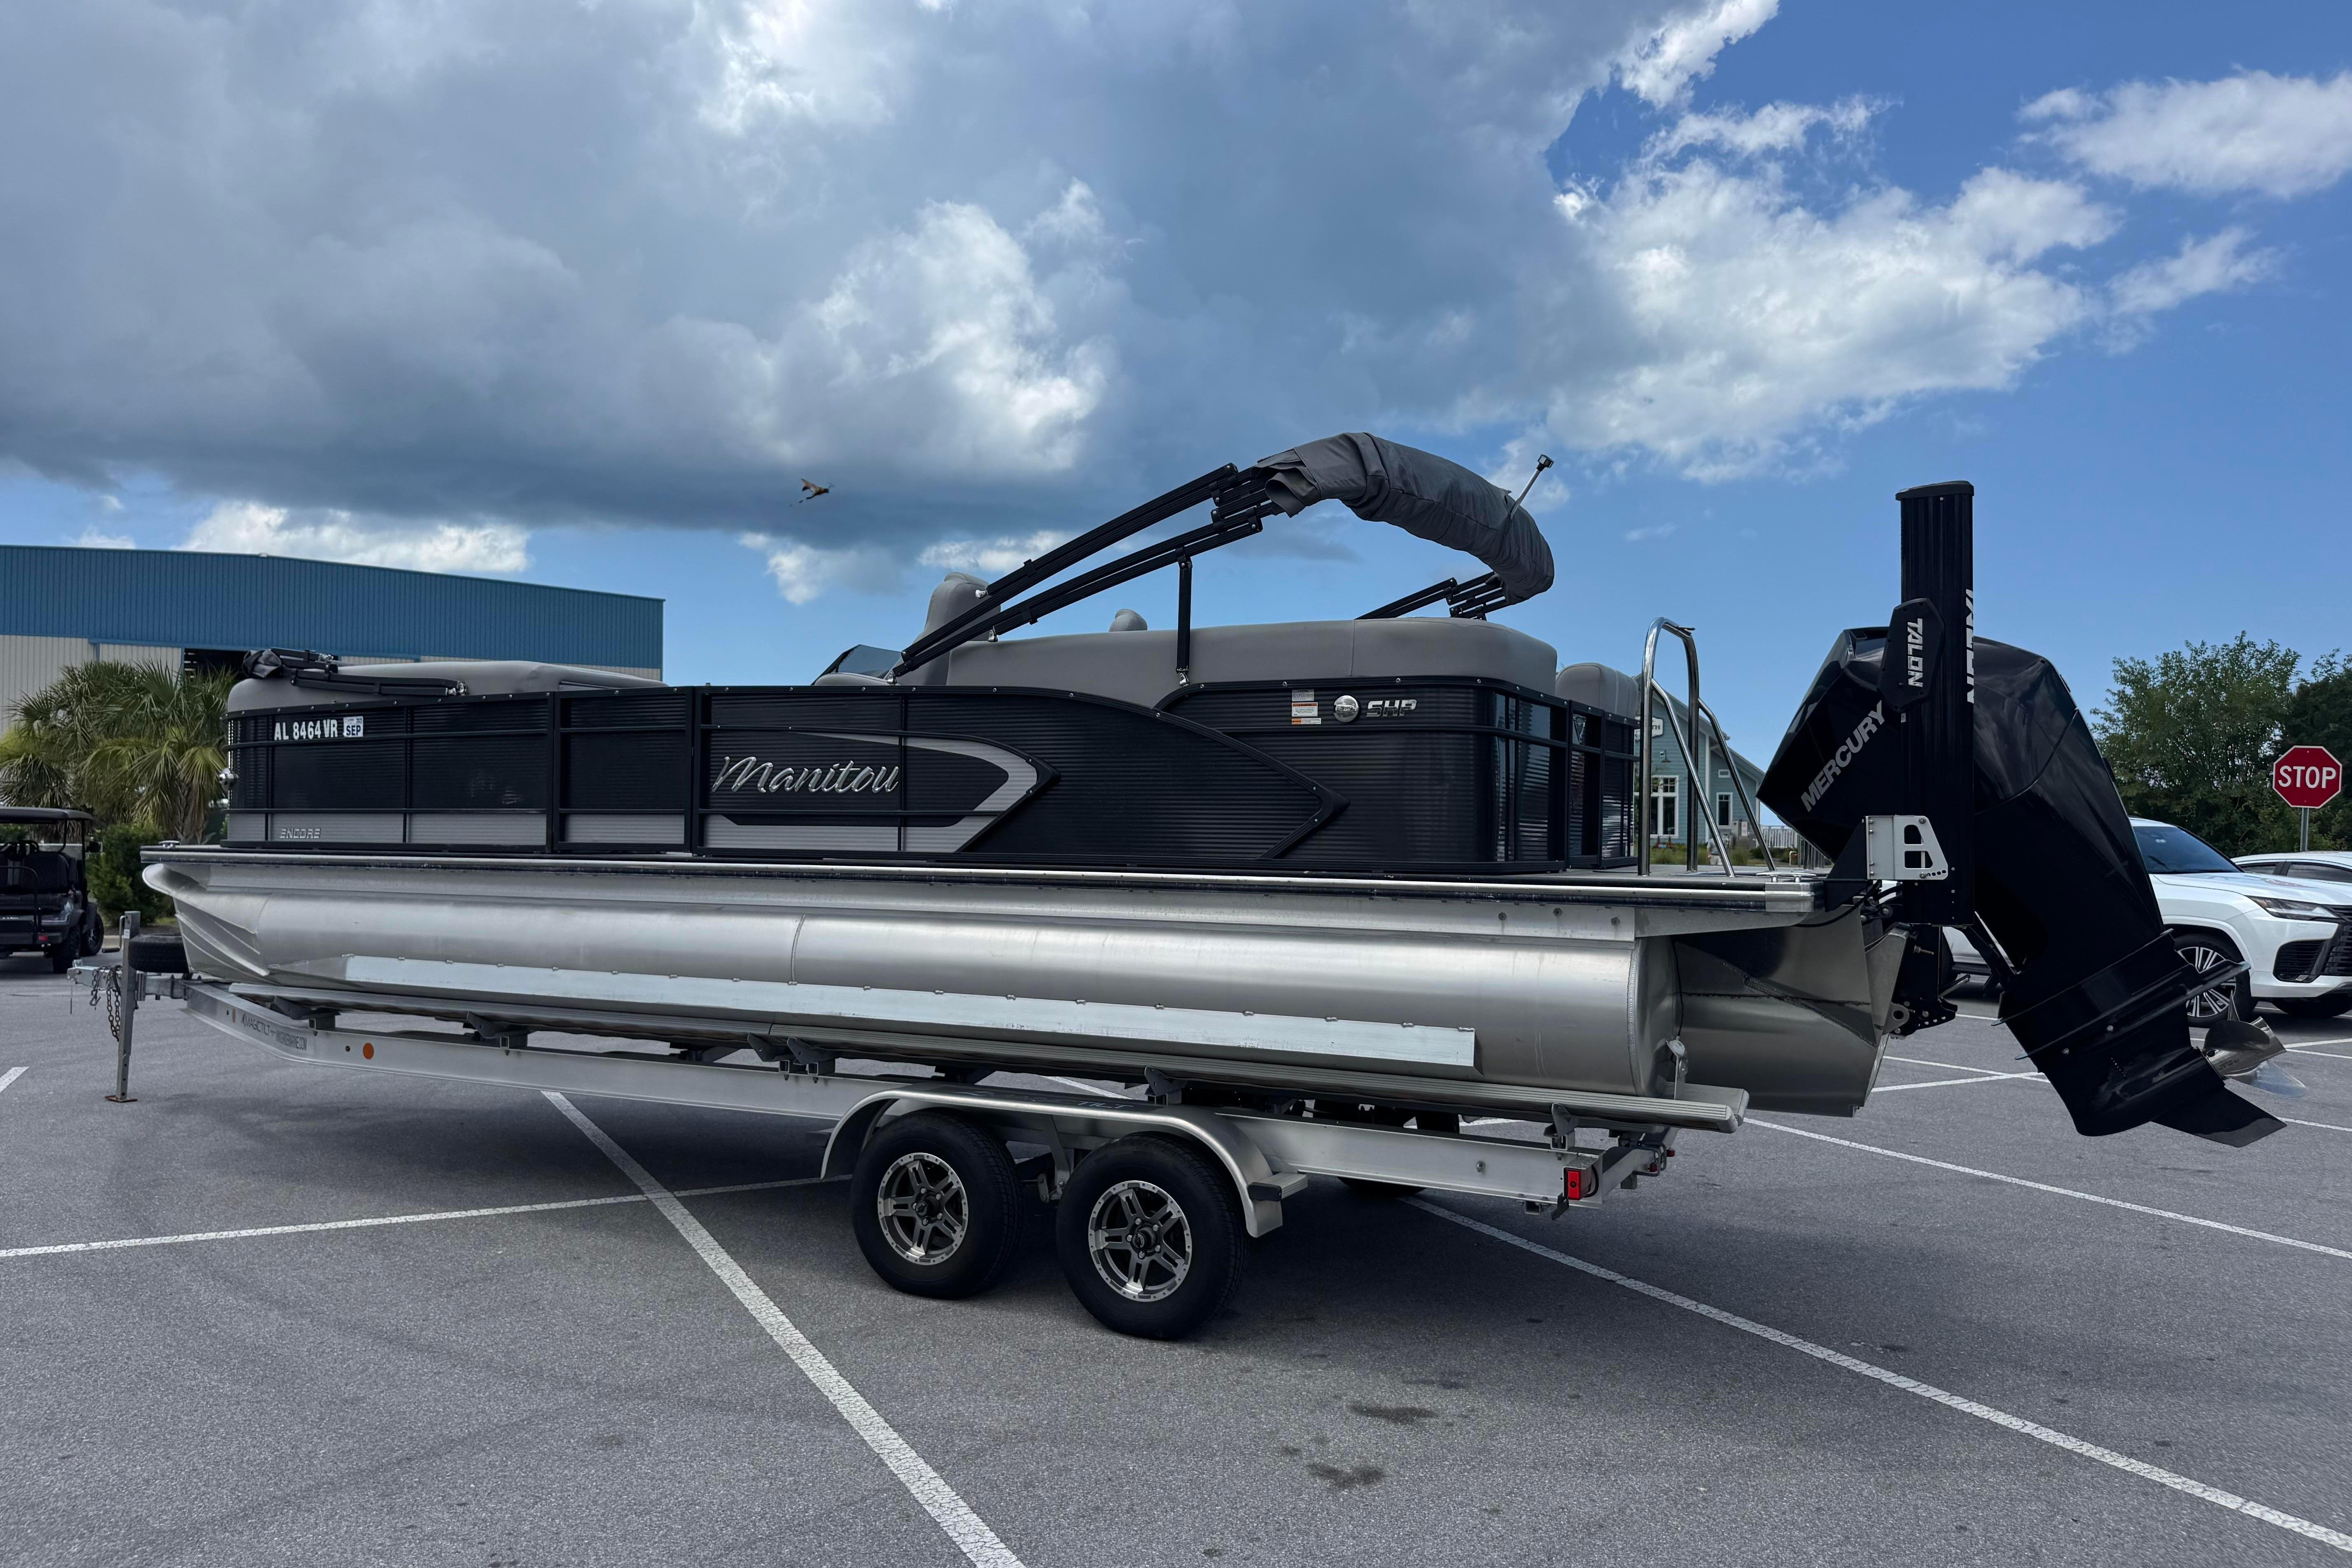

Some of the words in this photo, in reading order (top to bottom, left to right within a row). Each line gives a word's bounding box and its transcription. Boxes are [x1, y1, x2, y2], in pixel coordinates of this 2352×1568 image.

[1907, 618, 1923, 687] TALON
[1366, 699, 1416, 717] SHP
[274, 722, 289, 740] AL
[293, 721, 321, 740] 8464
[323, 719, 338, 737] VR
[346, 725, 361, 735] SEP
[1801, 700, 1885, 812] MERCURY
[712, 756, 899, 793] Manitou
[2278, 765, 2336, 789] STOP
[280, 828, 320, 838] ENCORE
